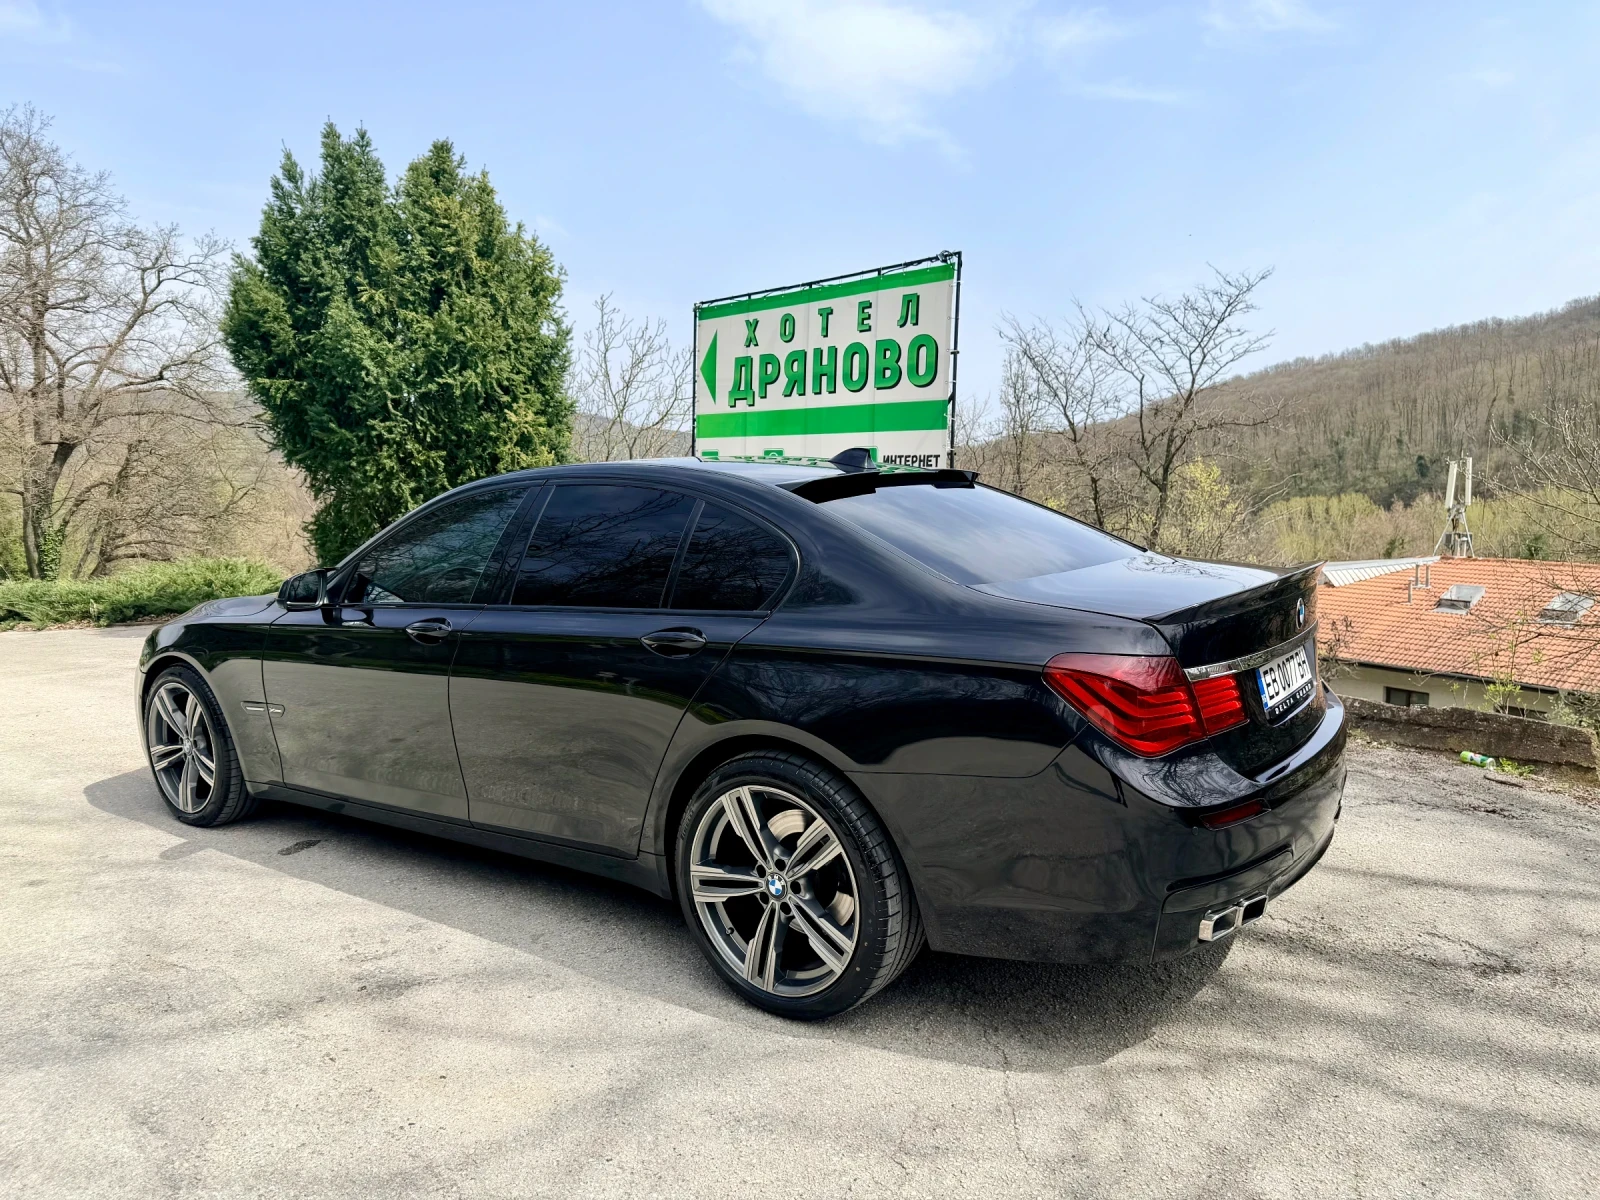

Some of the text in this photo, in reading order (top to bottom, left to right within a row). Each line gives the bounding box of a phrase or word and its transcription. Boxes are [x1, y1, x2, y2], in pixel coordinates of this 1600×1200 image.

[744, 292, 920, 347] ХОТЕЛ
[728, 333, 939, 408] ДРЯНОВО
[883, 454, 941, 468] ИНТЕРНЕТ
